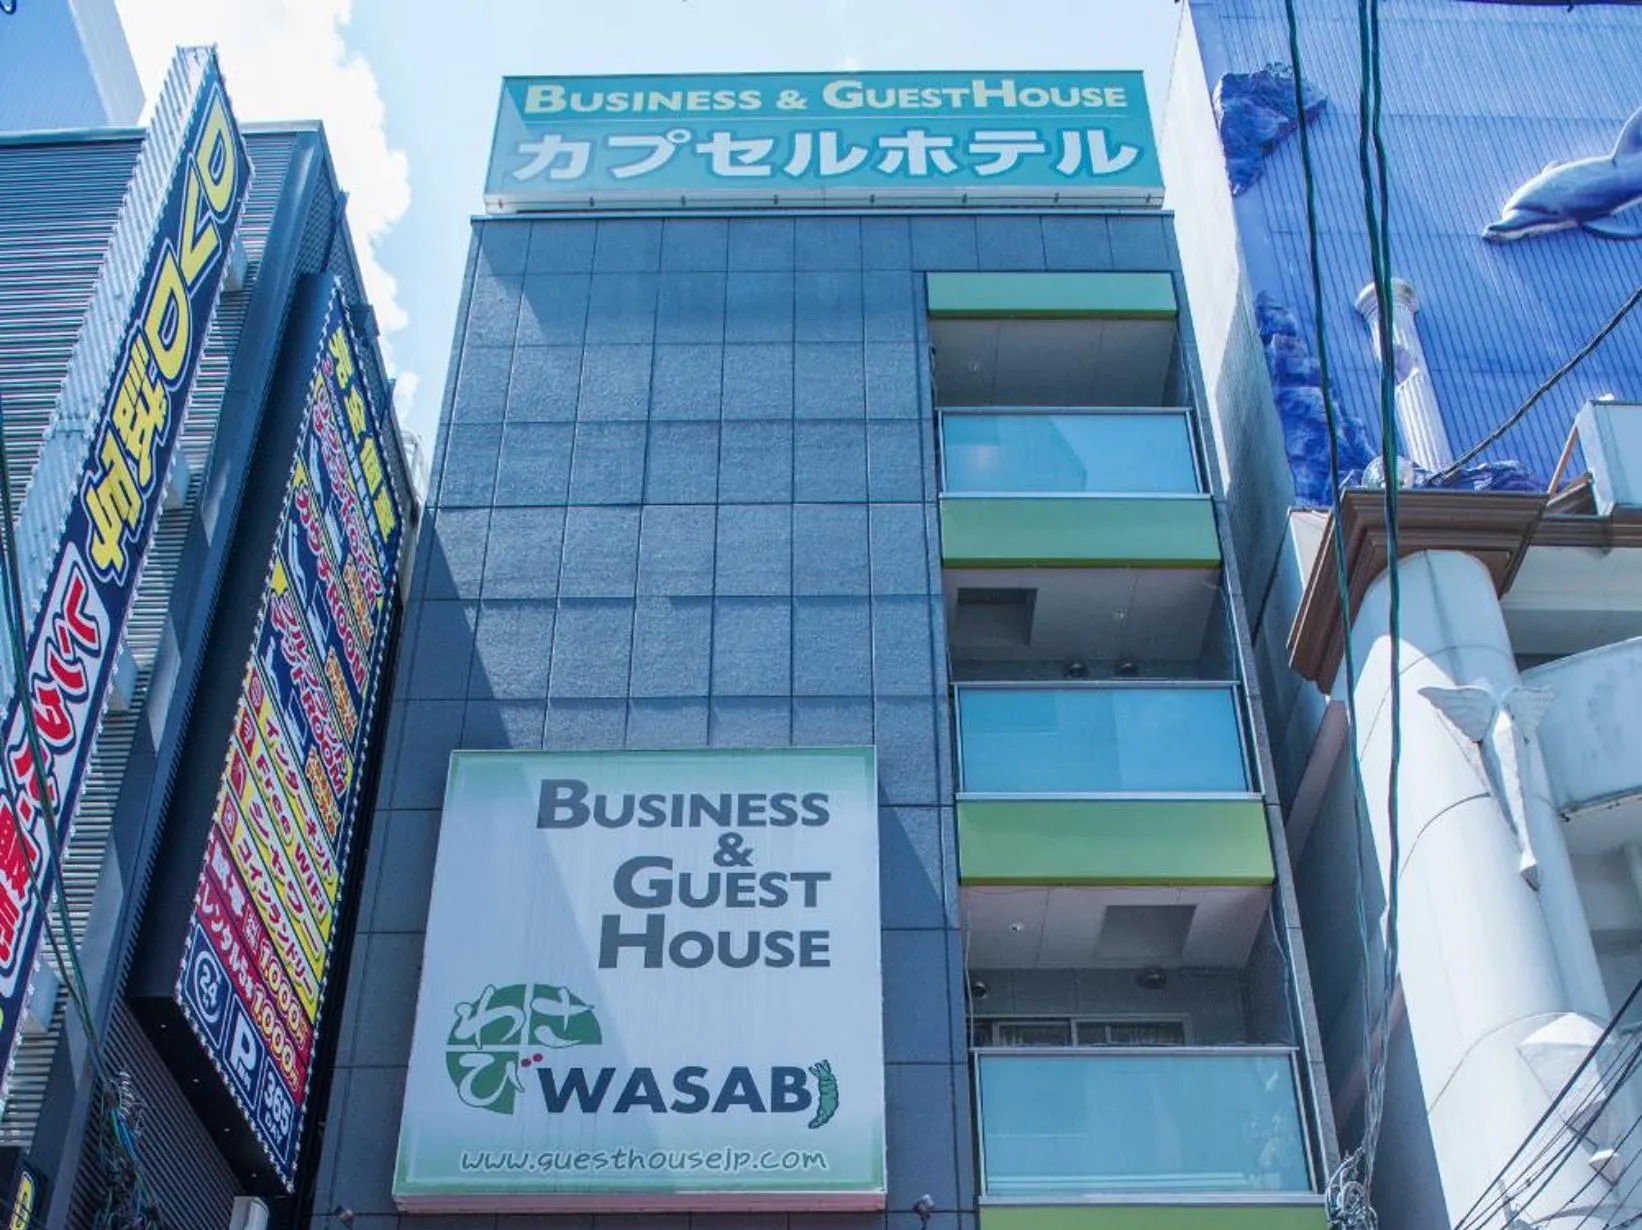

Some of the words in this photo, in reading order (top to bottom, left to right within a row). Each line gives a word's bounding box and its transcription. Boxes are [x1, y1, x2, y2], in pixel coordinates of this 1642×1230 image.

[524, 84, 762, 114] BUSINESS
[776, 88, 808, 111] &
[512, 128, 1138, 182] カプセルホテル
[256, 755, 291, 836] Free
[537, 779, 831, 830] BUSINESS
[248, 798, 323, 953] シャワー
[713, 831, 754, 867] &
[613, 856, 832, 909] GUEST
[598, 914, 832, 969] HOUSE
[230, 1010, 257, 1071] P
[264, 1070, 292, 1136] 365
[461, 1146, 829, 1174] www.guesthousejp.com
